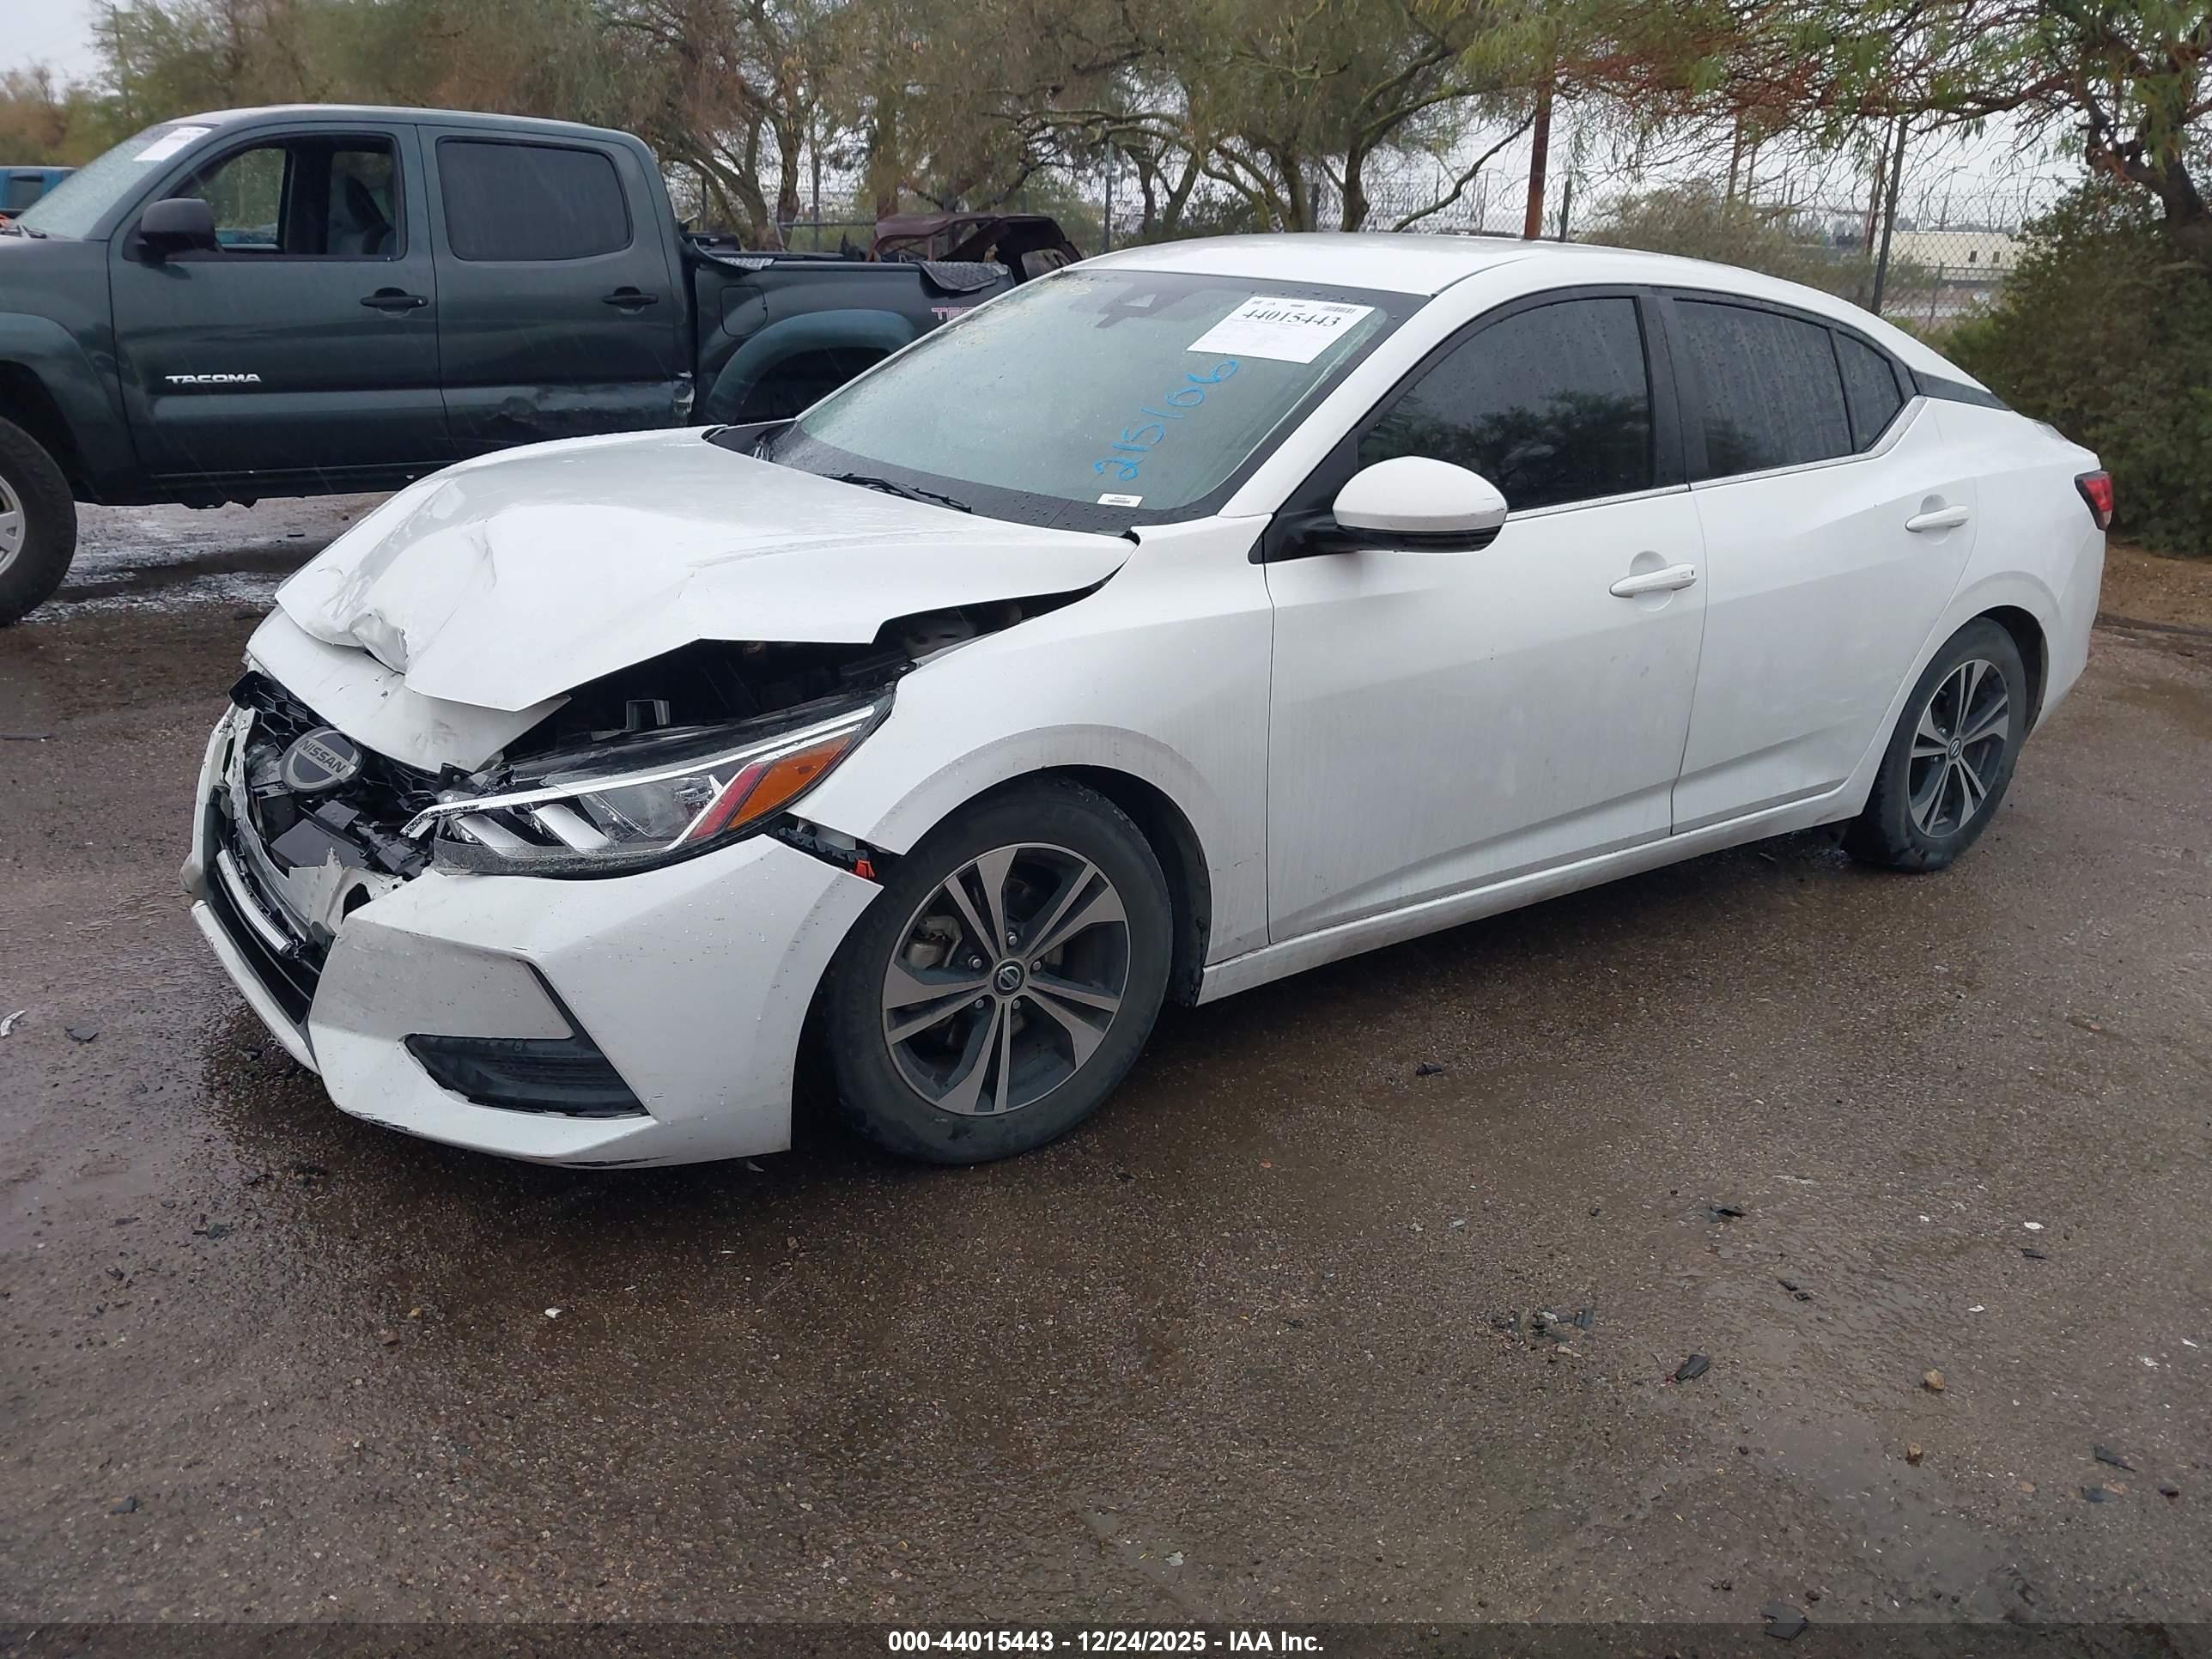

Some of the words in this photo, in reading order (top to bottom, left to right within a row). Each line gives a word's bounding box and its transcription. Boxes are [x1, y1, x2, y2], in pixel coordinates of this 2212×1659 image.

[931, 307, 976, 320] TR
[1243, 308, 1341, 327] 44015443
[164, 374, 262, 384] TACOMA
[299, 740, 347, 774] NISSAN
